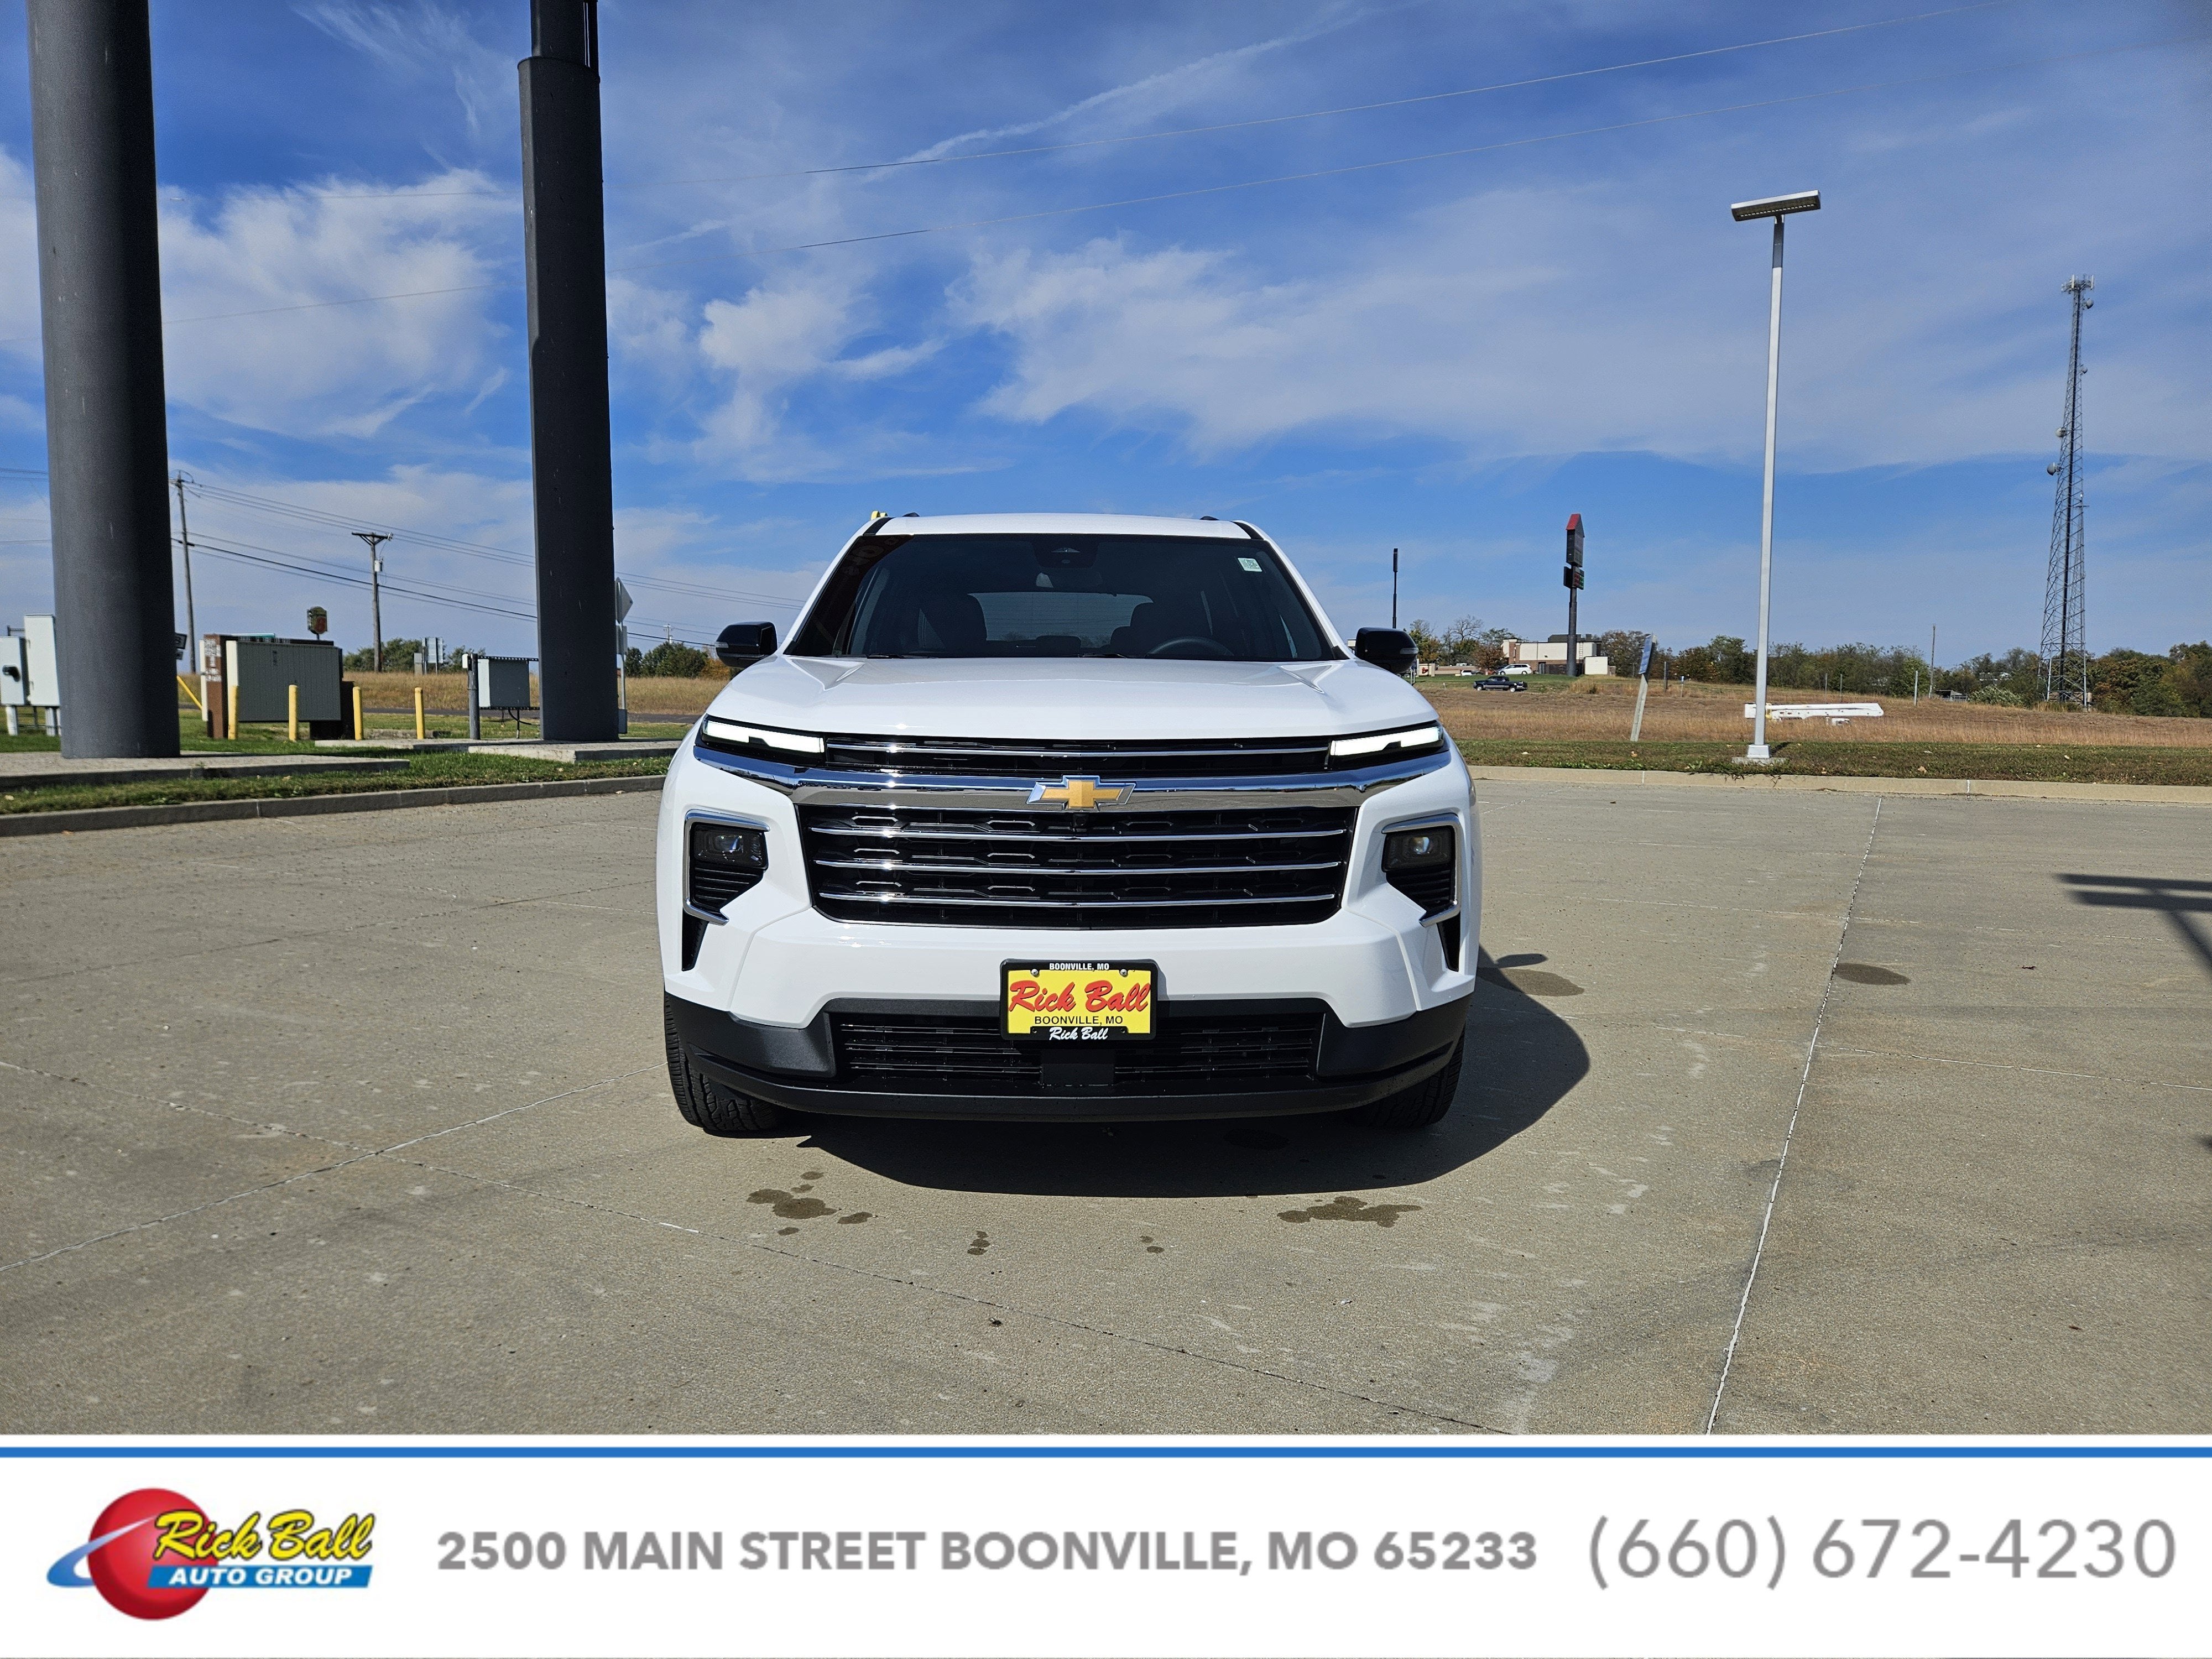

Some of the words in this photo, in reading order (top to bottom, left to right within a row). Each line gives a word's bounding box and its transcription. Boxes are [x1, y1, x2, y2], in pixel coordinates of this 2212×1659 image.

[1049, 963, 1094, 971] BOONVILLE,
[1009, 980, 1076, 1012] Rick
[1084, 980, 1151, 1013] Ball
[1035, 1016, 1102, 1026] BOONVILLE,
[1106, 1016, 1123, 1024] MO
[1049, 1027, 1078, 1040] Rick
[1081, 1027, 1108, 1040] Ball
